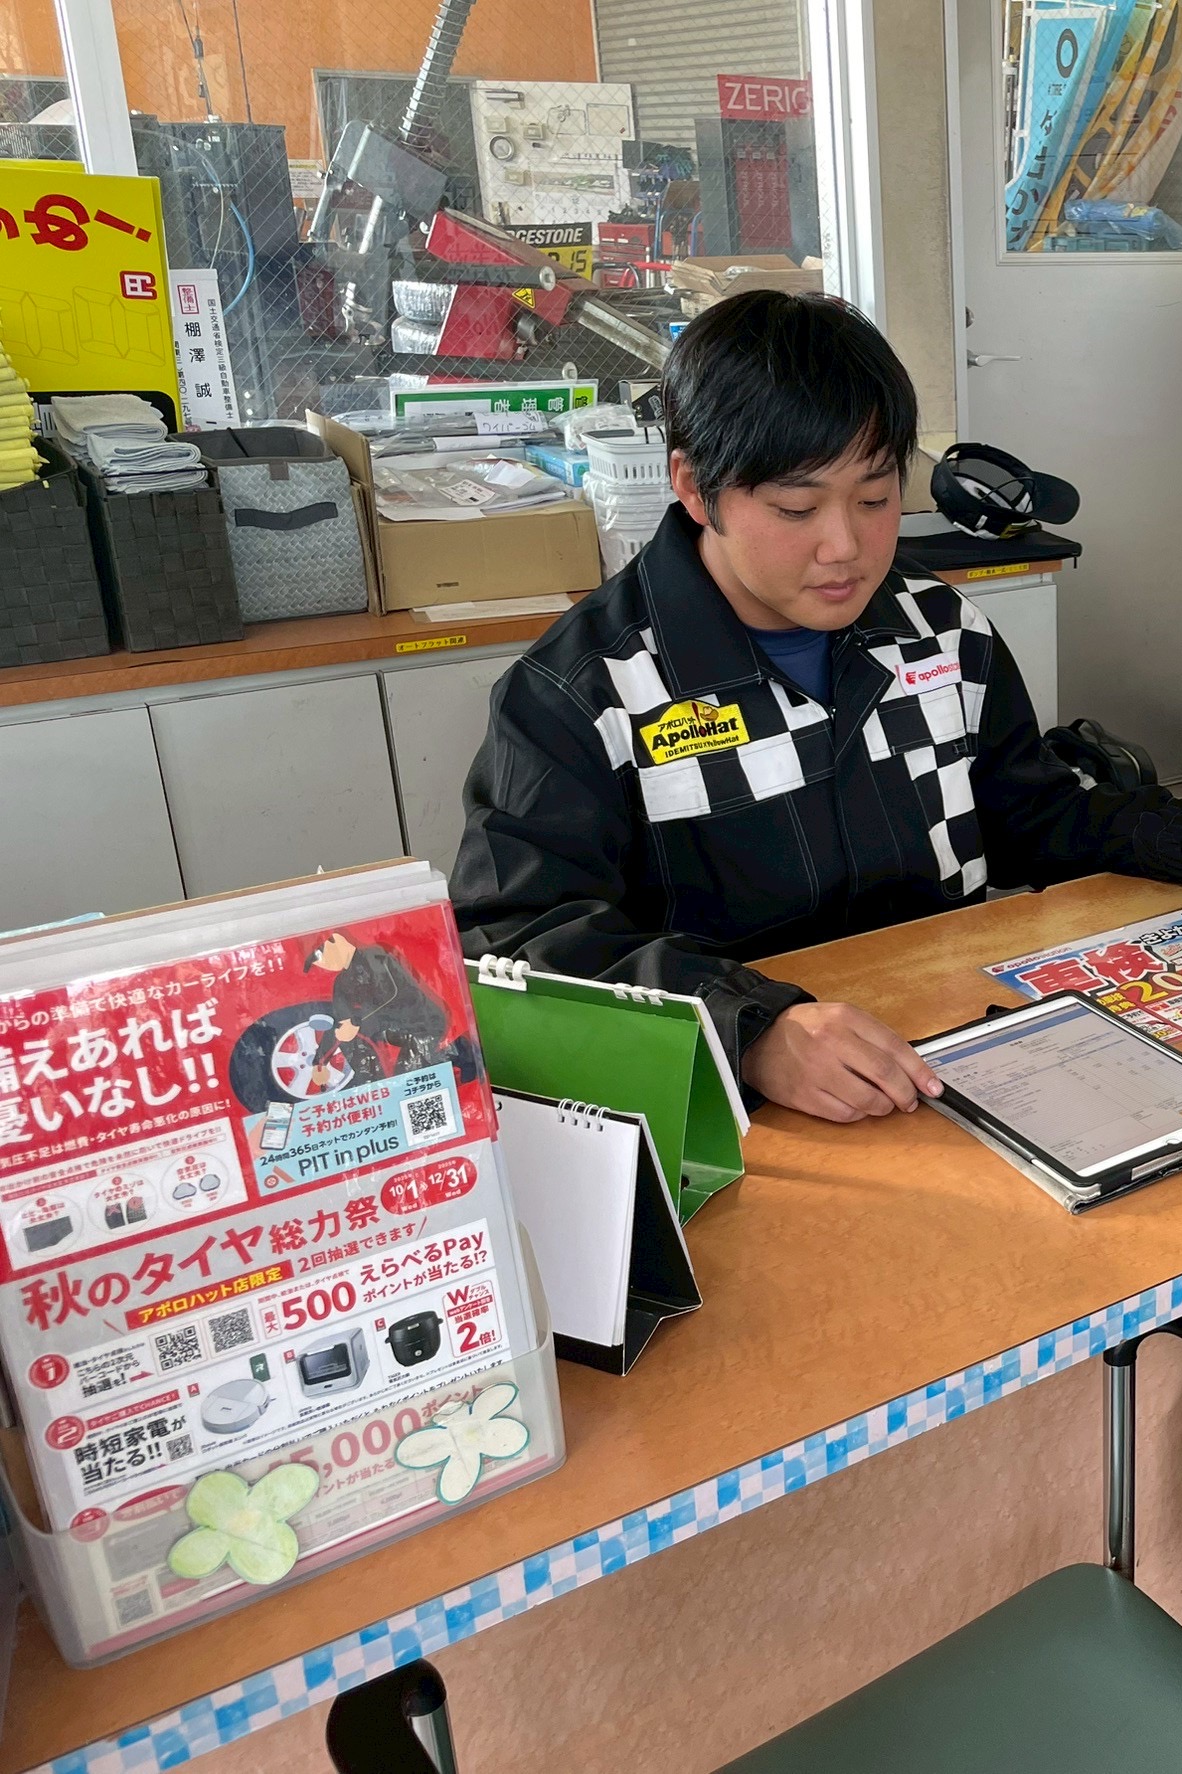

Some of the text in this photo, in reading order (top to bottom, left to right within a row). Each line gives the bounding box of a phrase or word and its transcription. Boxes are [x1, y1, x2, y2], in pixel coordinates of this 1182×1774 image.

[652, 717, 739, 751] ApolloHat
[1017, 940, 1165, 995] 車検
[404, 1080, 442, 1097] コチラから
[405, 1072, 437, 1088] ご予約は
[298, 1087, 391, 1122] ご予約はWEB
[301, 1104, 384, 1138] 予約が便利!
[298, 1135, 400, 1177] PIT in plus
[21, 1194, 383, 1332] 秋のタイヤ総力祭
[297, 1222, 417, 1274] 2回抽選できます
[360, 1231, 485, 1286] えらべるPay
[138, 1267, 284, 1324] アポロハット店限定
[363, 1250, 488, 1304] ポイントが当たる!?
[446, 1285, 470, 1307] W
[281, 1280, 357, 1331] 500
[456, 1321, 497, 1353] 2 倍!
[75, 1414, 187, 1466] 時短家電が
[81, 1442, 162, 1486] 当たる!!
